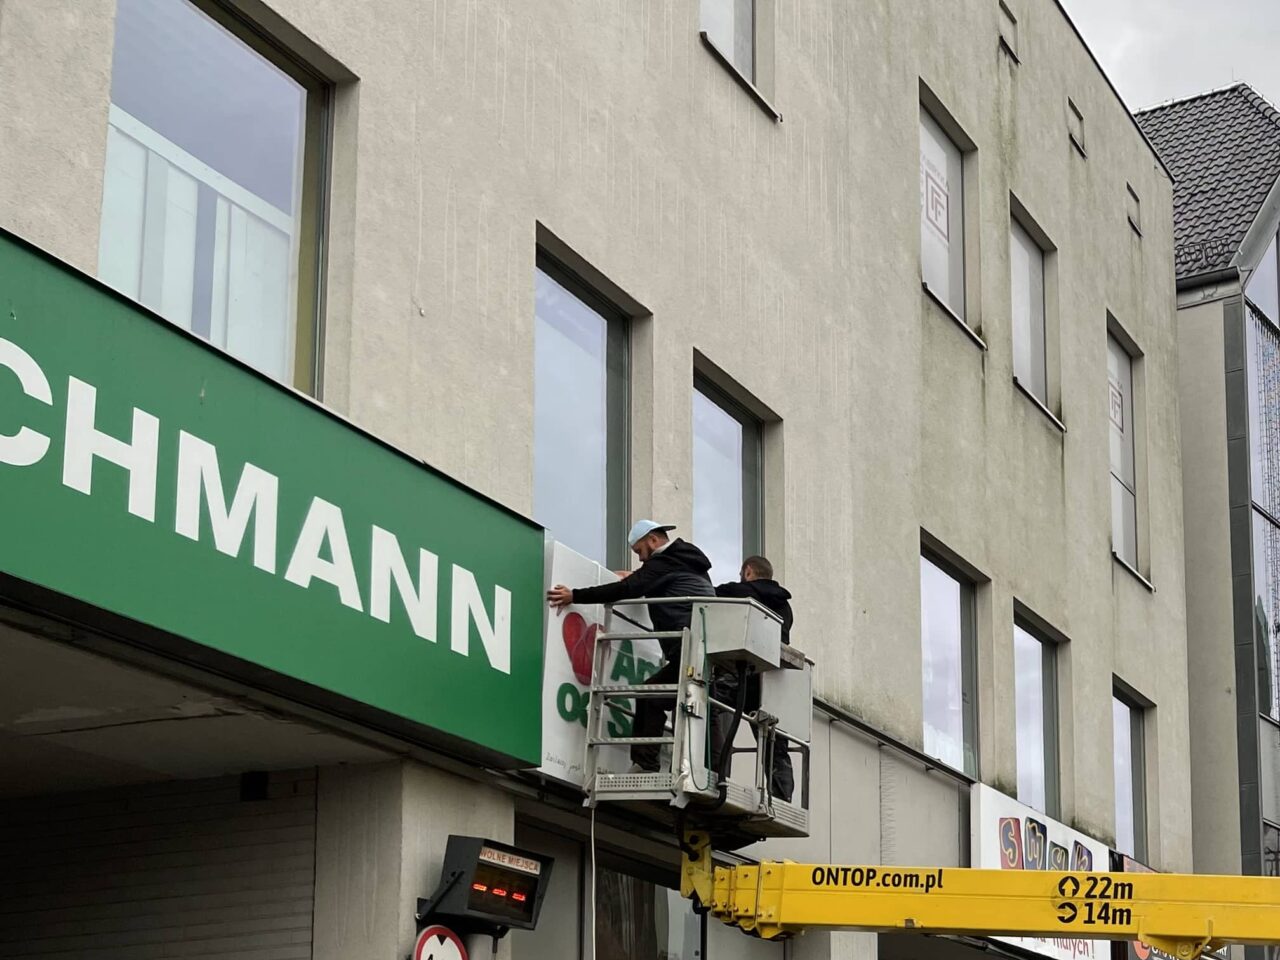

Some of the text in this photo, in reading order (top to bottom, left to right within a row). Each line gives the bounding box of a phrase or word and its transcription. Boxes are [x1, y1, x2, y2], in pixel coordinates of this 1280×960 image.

[811, 866, 943, 893] ONTOP.com.pl
[1084, 876, 1133, 899] 22m
[1083, 902, 1132, 925] 14m
